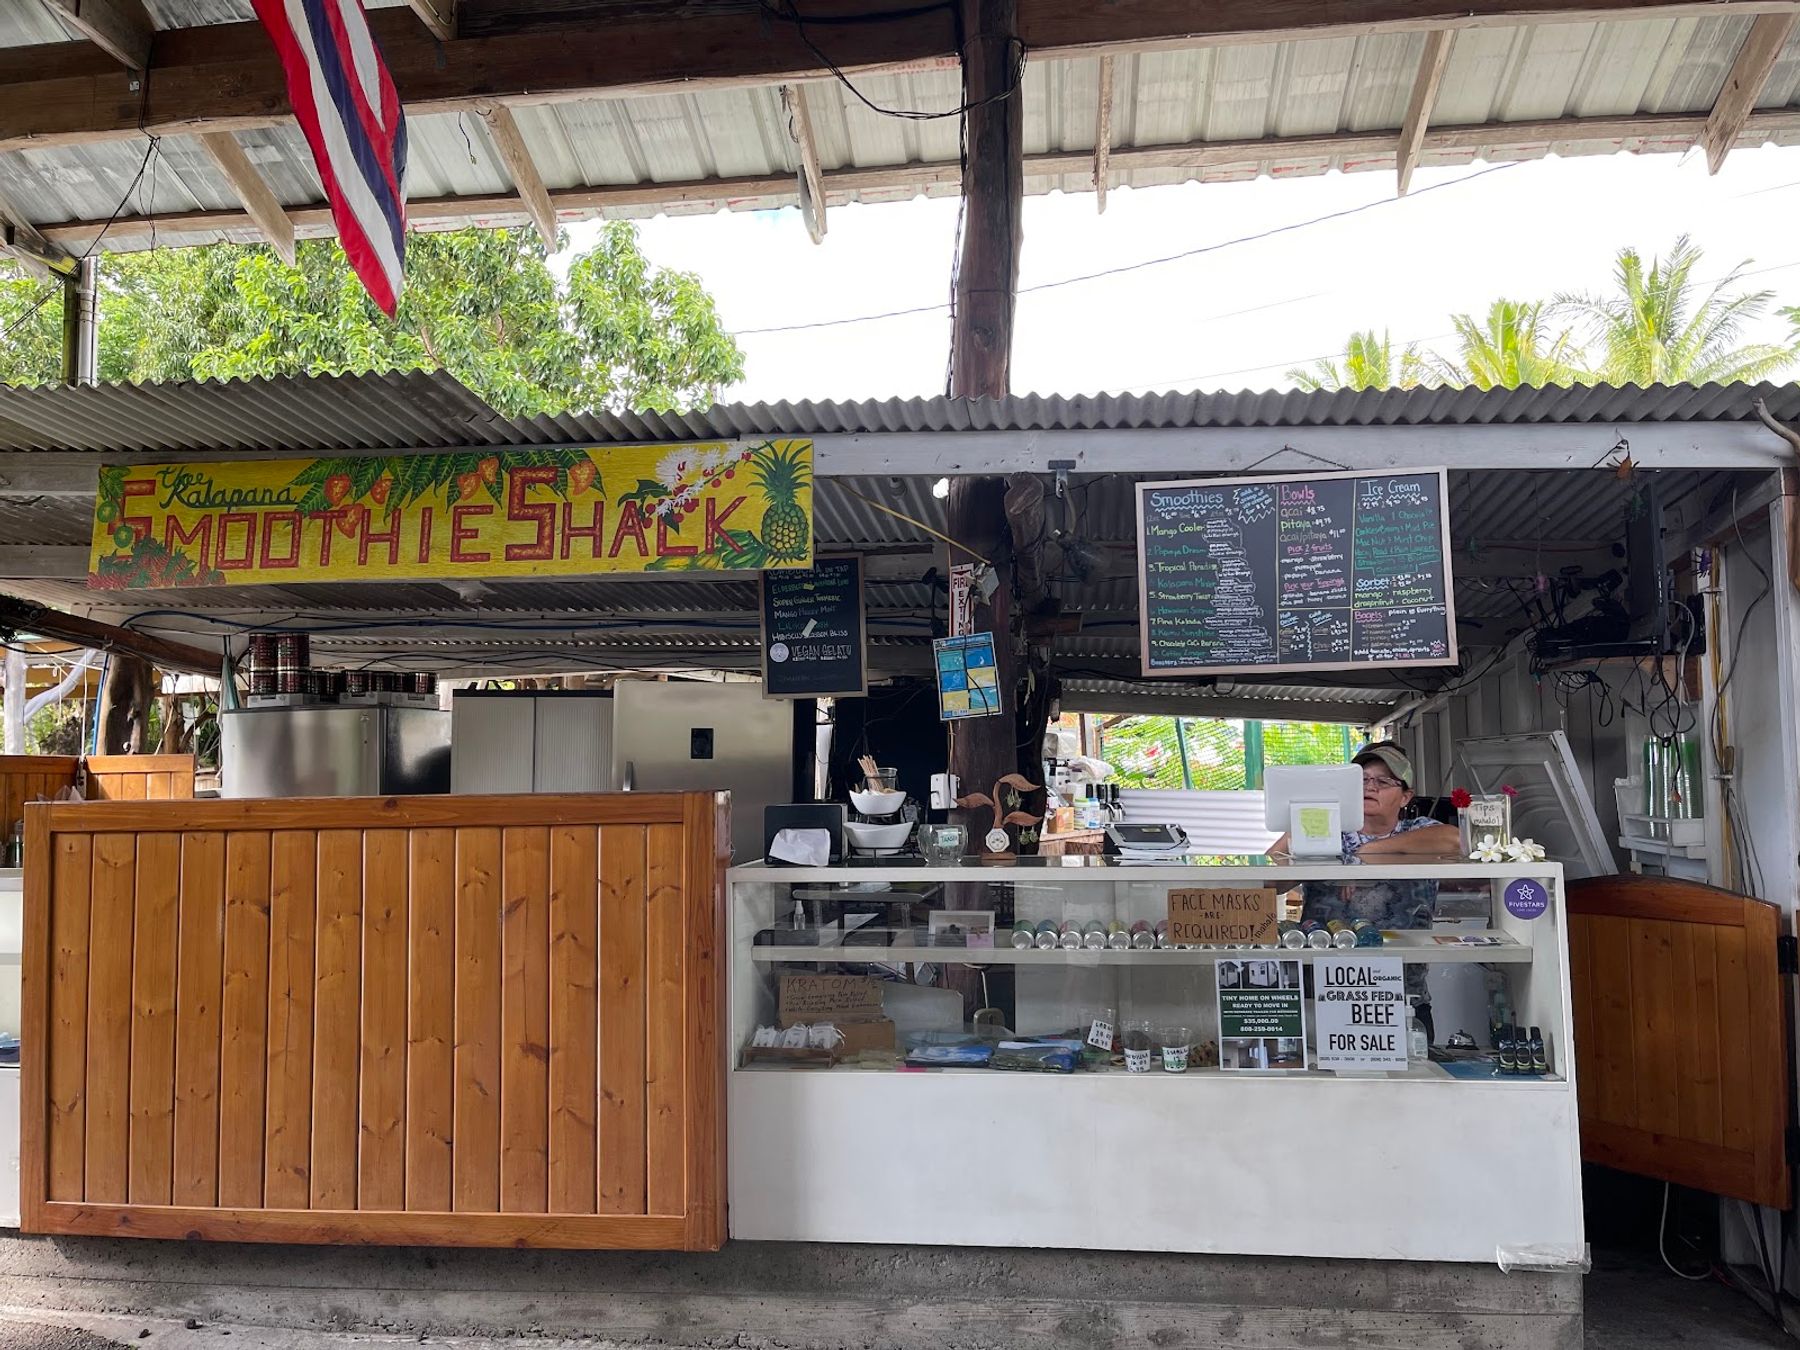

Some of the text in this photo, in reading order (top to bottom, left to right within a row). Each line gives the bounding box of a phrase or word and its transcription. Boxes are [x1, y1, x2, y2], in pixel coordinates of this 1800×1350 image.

[160, 477, 300, 514] Kalapana
[1281, 484, 1316, 501] Bowls
[1360, 479, 1421, 496] Ice Cream
[1150, 489, 1225, 507] Smoothies
[107, 465, 747, 574] SMOOTHIE SHACK
[1280, 519, 1313, 532] pitaya
[1151, 521, 1204, 538] Mango Cooler
[1155, 561, 1187, 574] Tropical
[1158, 591, 1193, 602] Strawberry
[1354, 587, 1433, 600] mango raspberry
[1388, 607, 1408, 617] plain
[791, 644, 852, 657] VEGAN GELATO
[1171, 892, 1261, 912] FACE MASKS
[1173, 911, 1278, 942] REQUIRED! mahalo
[1325, 966, 1378, 986] LOCAL
[786, 977, 859, 994] KRATOM
[1326, 990, 1395, 1002] GRASS FED
[1351, 1003, 1395, 1025] BEEF
[1329, 1033, 1397, 1051] FOR SALE
